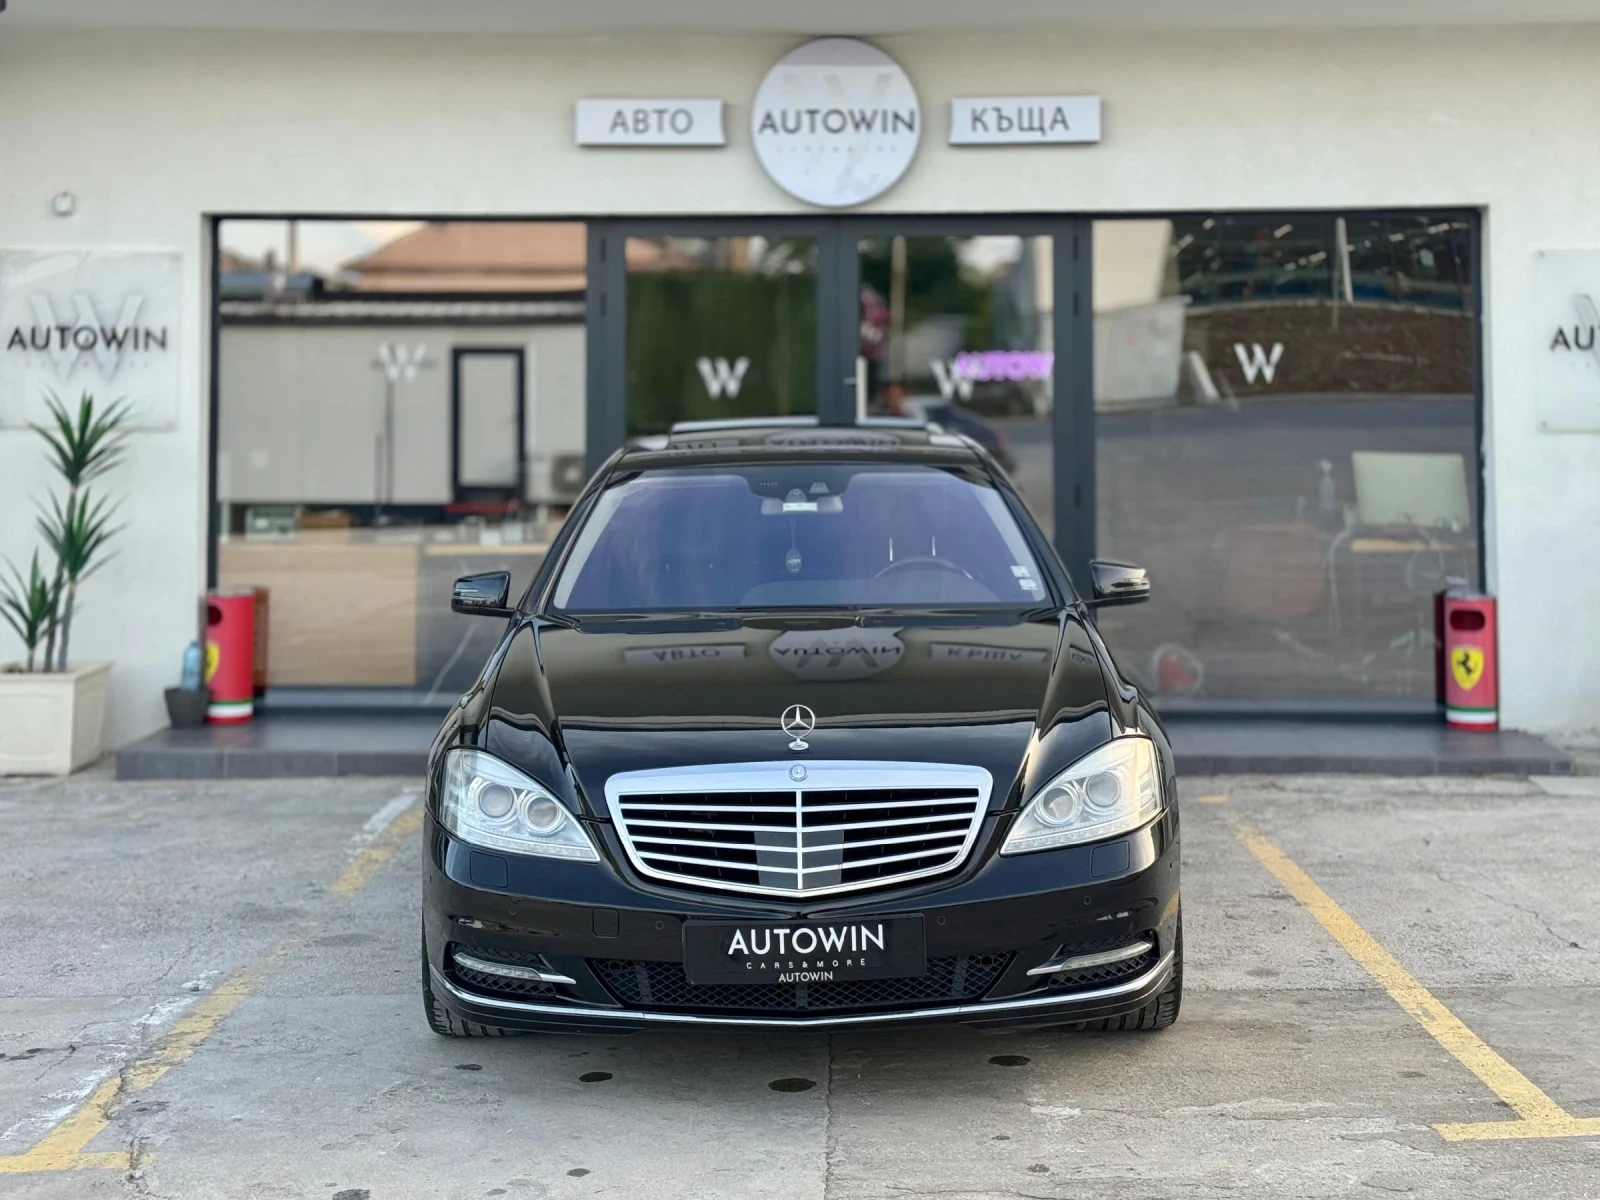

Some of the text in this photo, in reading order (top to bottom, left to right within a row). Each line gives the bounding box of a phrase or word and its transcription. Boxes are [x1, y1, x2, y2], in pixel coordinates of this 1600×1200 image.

[609, 108, 693, 135] АВТО
[758, 109, 916, 135] AUTOWIN
[971, 106, 1070, 137] КЪЩА
[7, 326, 168, 351] AUTOWIN
[1550, 325, 1600, 351] AU
[377, 341, 427, 381] W
[1233, 342, 1285, 385] W
[696, 356, 750, 399] W
[728, 924, 884, 955] AUTOWIN
[778, 971, 834, 983] AUTOWIN
